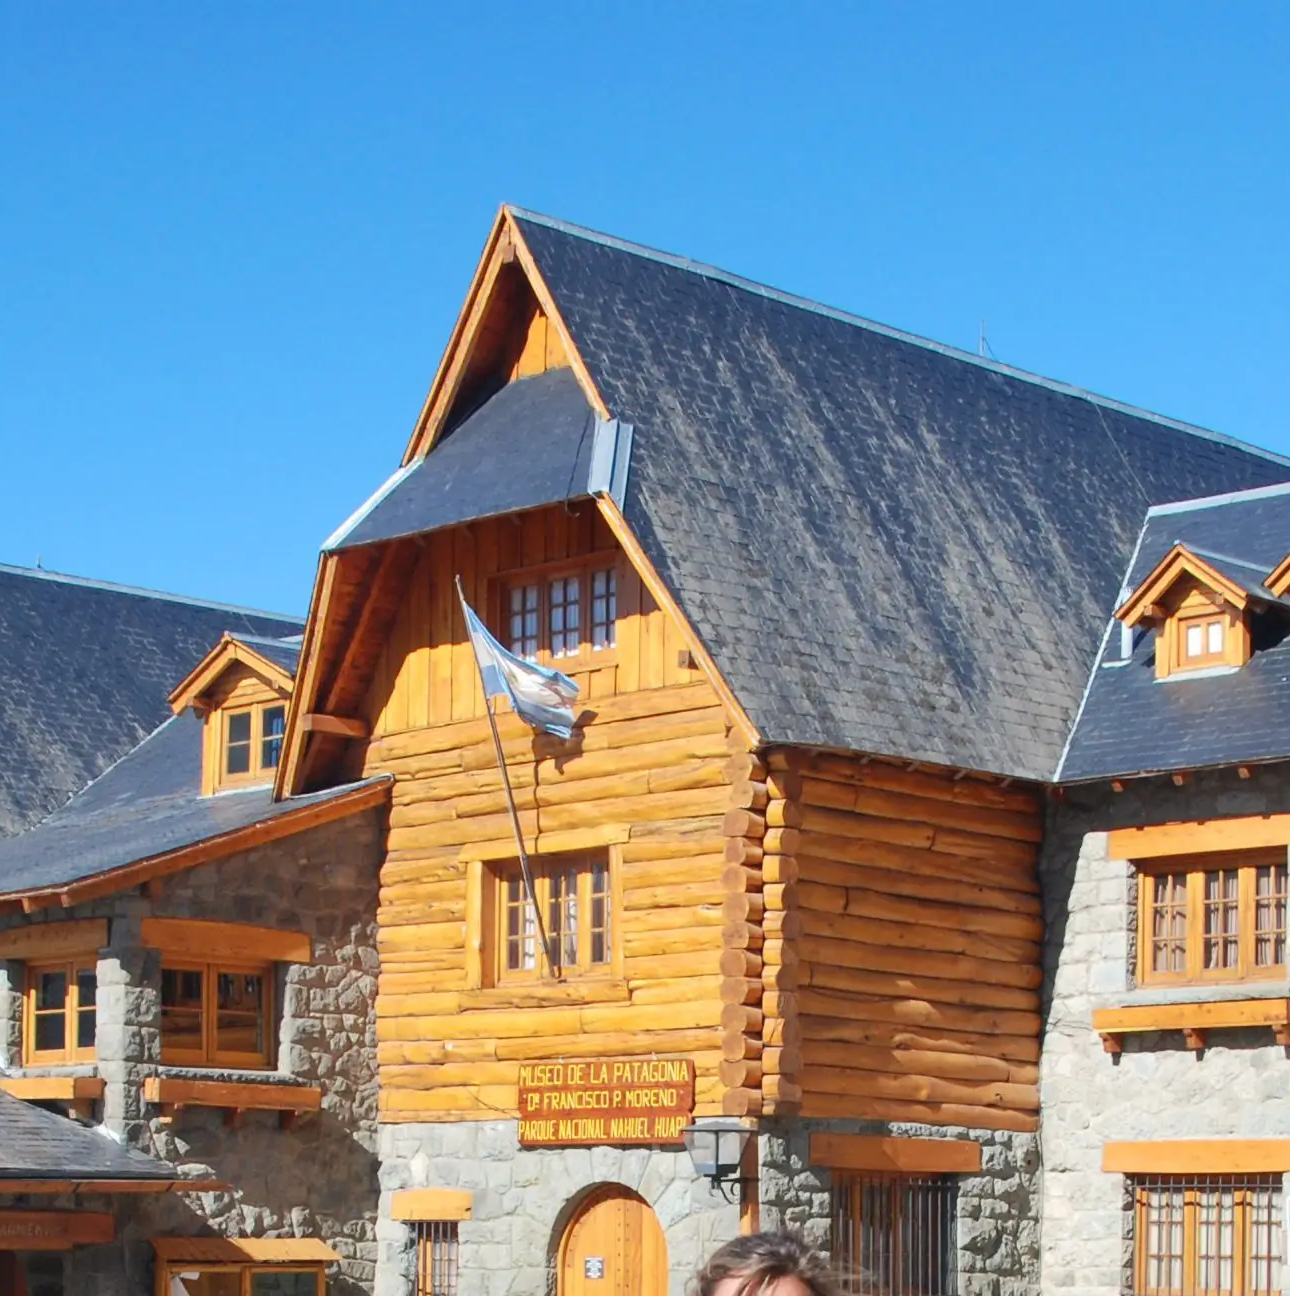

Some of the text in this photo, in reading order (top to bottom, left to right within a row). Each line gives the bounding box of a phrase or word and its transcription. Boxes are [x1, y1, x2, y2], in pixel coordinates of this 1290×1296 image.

[520, 1060, 689, 1086] MUSEO DE LA PATAGONIA
[543, 1090, 609, 1110] FRANCISCO
[625, 1088, 677, 1107] MORENO
[518, 1120, 557, 1141] PARQUE
[559, 1119, 608, 1140] NACIONAL
[610, 1117, 651, 1139] NAHUEL
